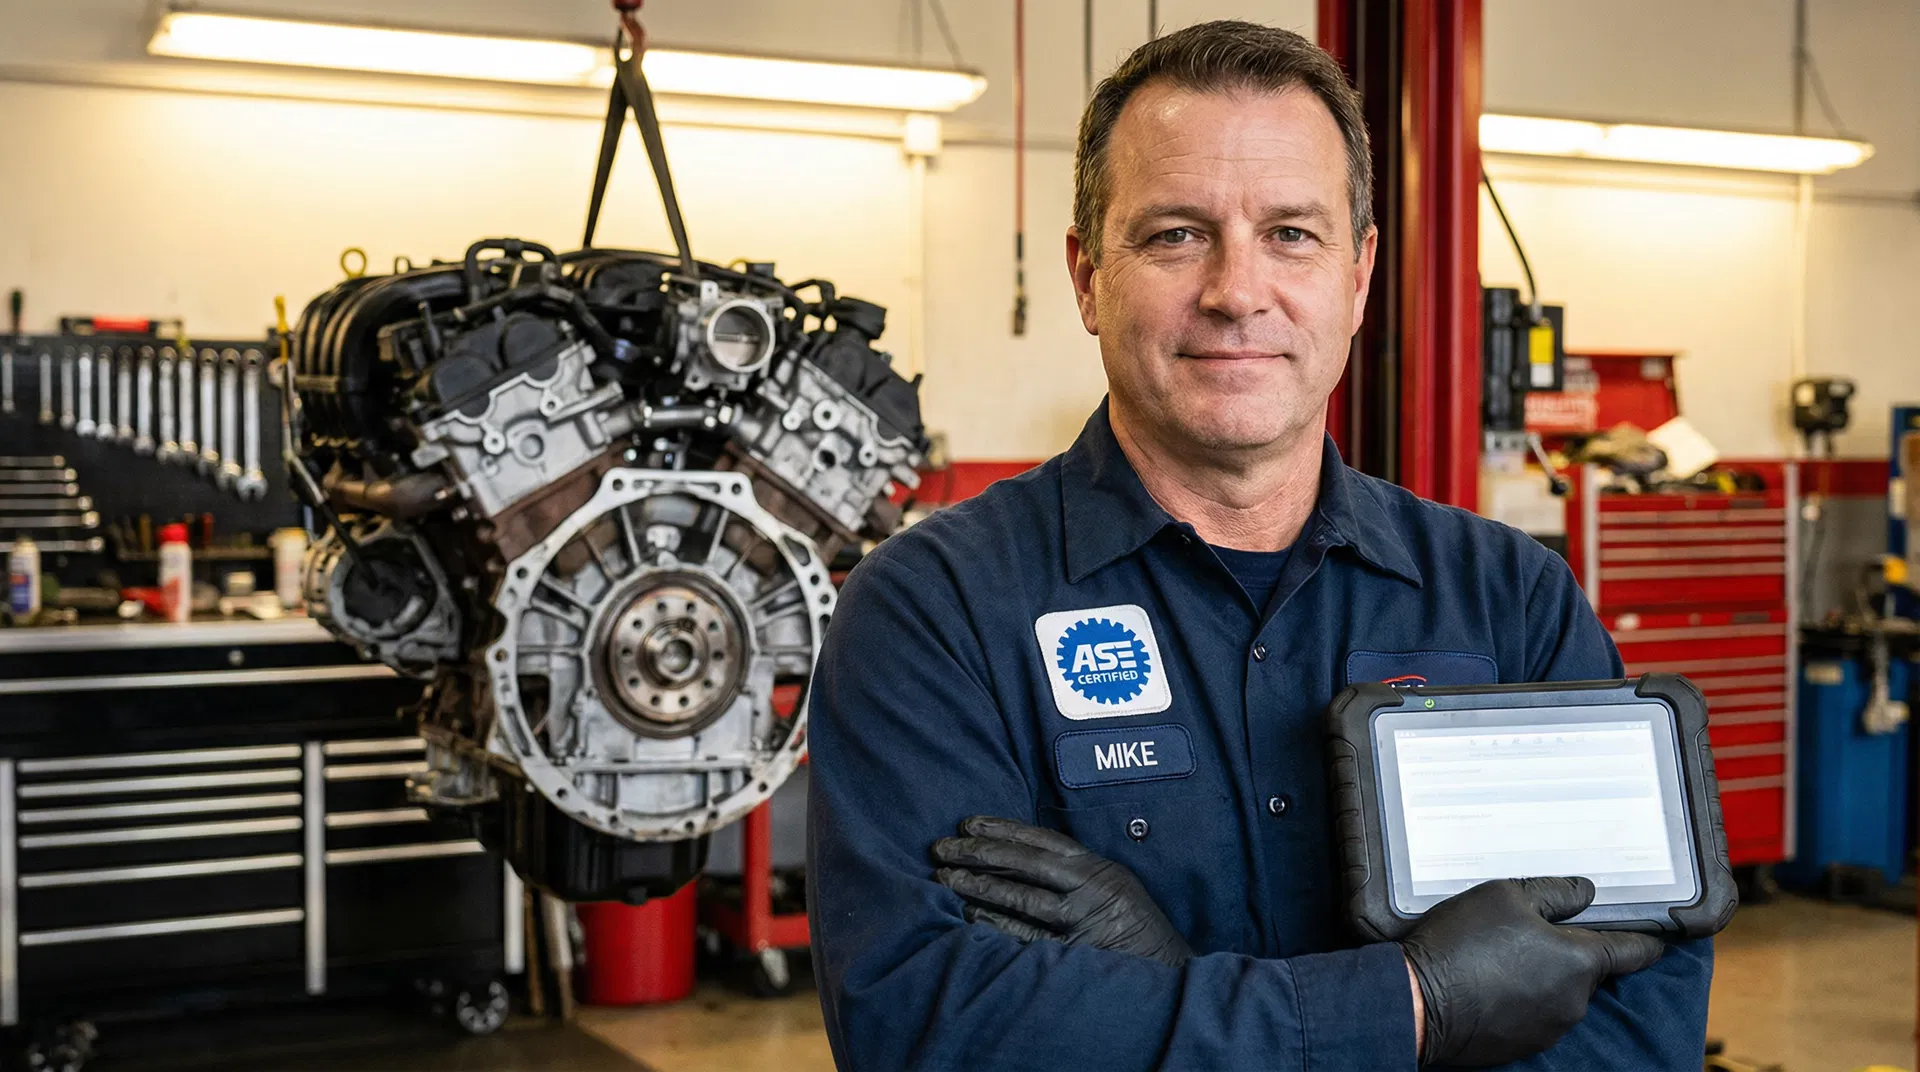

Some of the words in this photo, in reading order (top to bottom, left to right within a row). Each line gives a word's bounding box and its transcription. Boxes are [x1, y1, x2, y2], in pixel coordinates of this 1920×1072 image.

[1072, 641, 1137, 673] ASE
[1077, 670, 1138, 685] CERTIFIED
[1094, 741, 1158, 770] MIKE
